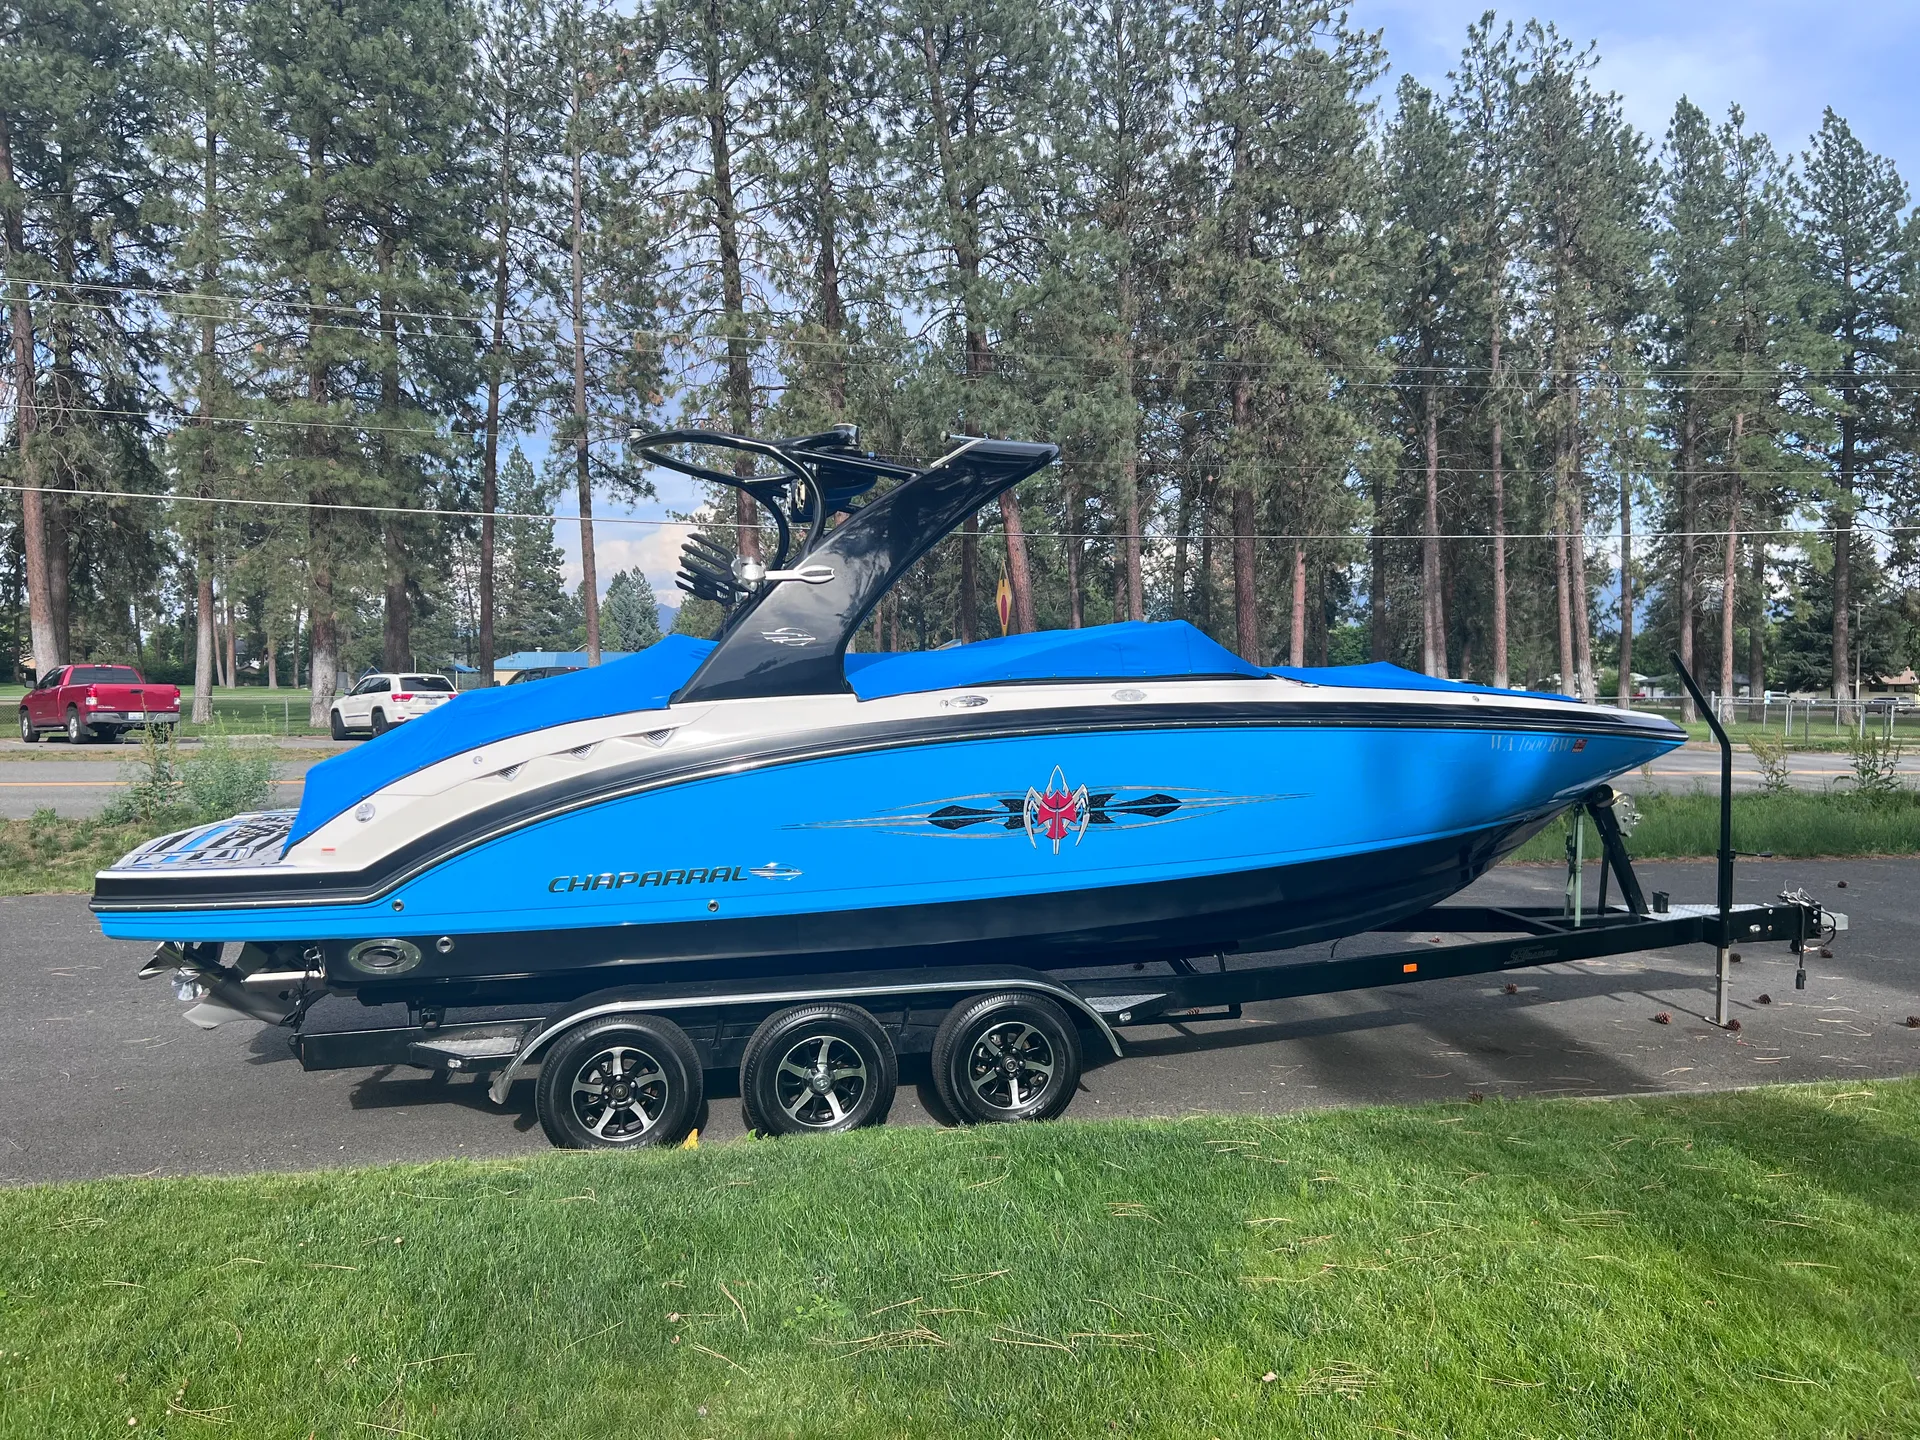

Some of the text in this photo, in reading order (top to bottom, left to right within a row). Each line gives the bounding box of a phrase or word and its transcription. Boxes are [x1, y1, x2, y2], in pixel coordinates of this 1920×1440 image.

[1491, 734, 1513, 752] WA
[1548, 737, 1573, 753] RW
[548, 866, 748, 893] CHAPARRAL
